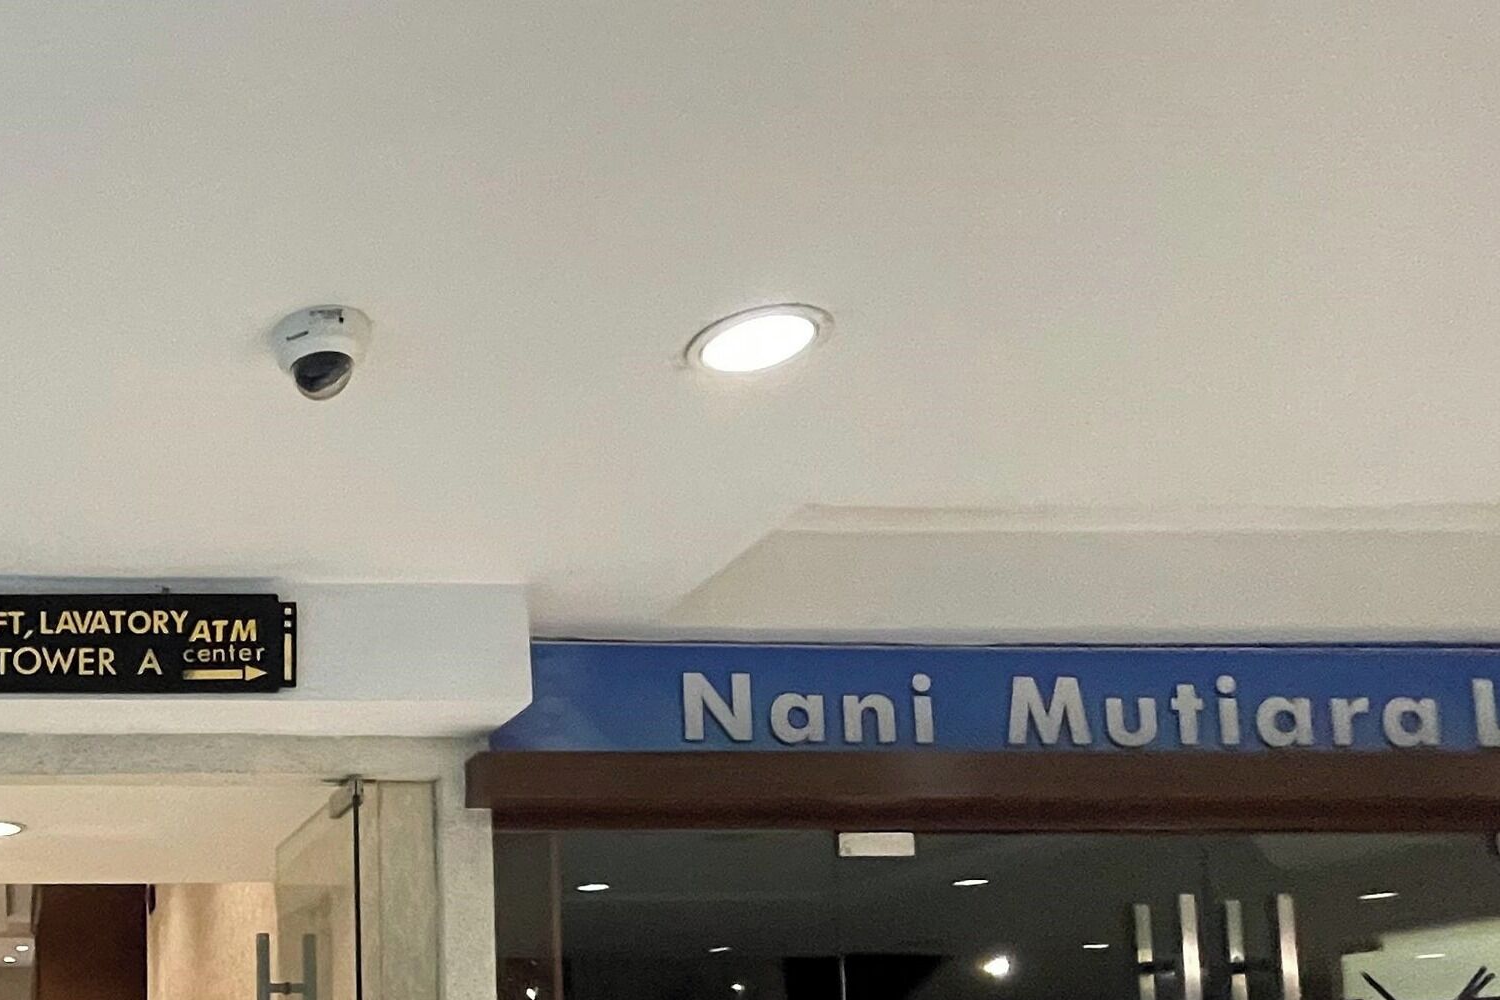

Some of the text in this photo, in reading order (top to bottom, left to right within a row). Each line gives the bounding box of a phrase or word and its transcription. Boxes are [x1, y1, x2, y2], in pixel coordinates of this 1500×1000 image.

[40, 610, 189, 635] LAVATORY
[190, 619, 257, 643] ATM
[137, 647, 162, 675] A
[183, 644, 265, 663] center
[682, 672, 933, 744] Nani
[1008, 674, 1440, 748] Mutiara
